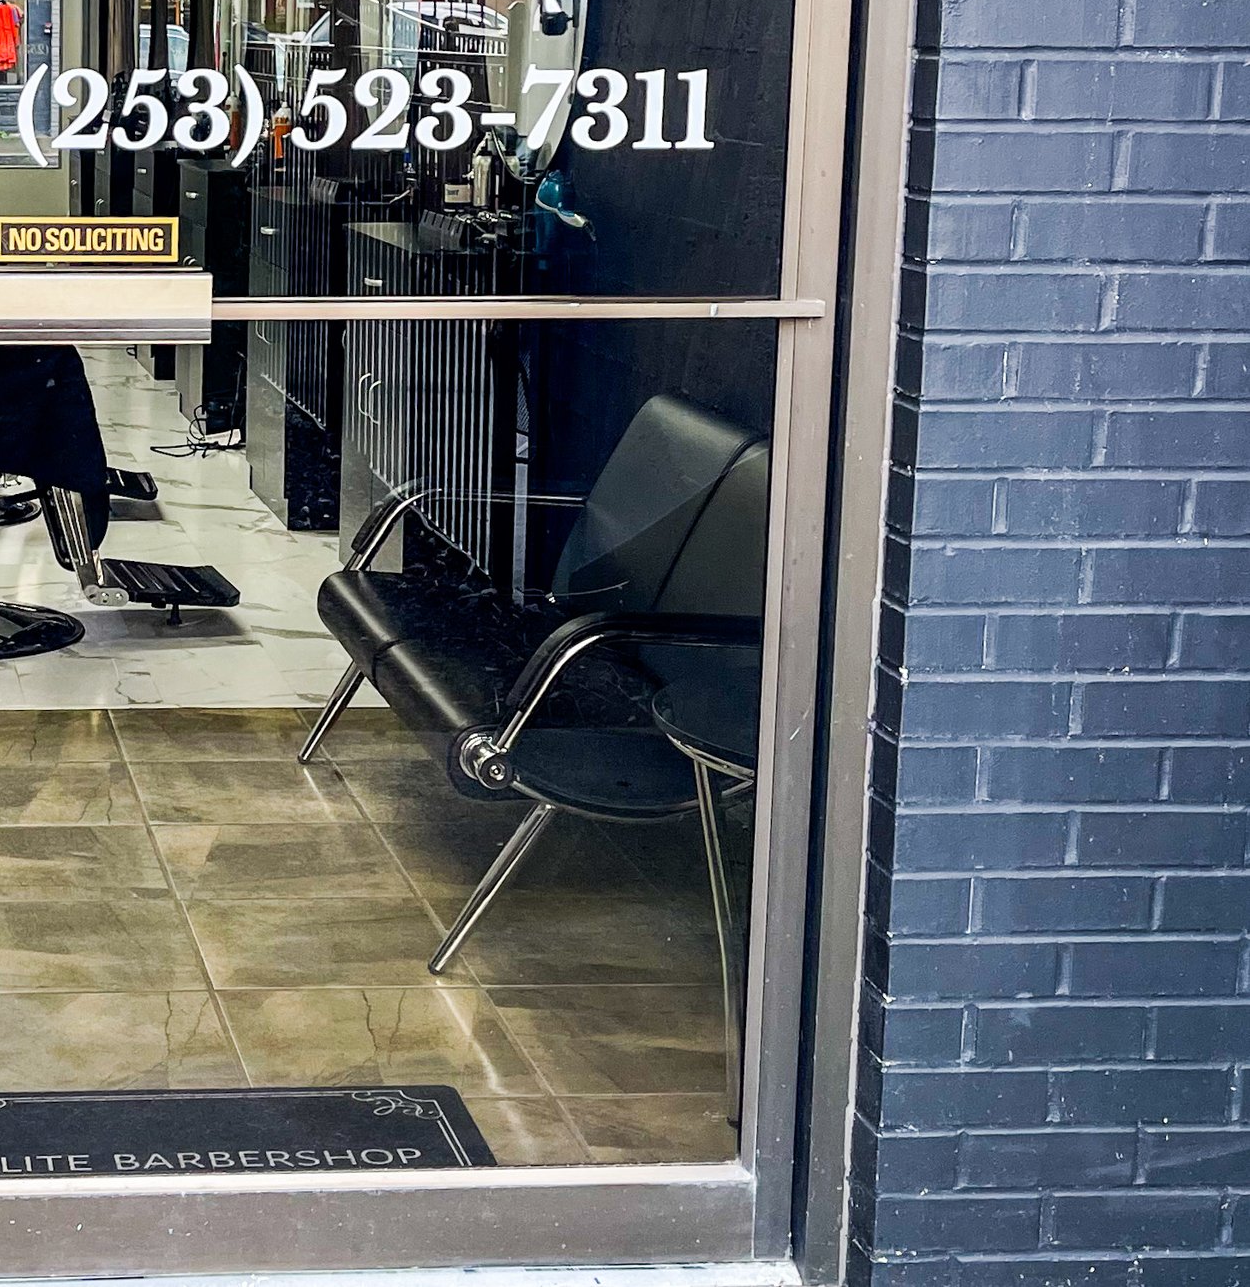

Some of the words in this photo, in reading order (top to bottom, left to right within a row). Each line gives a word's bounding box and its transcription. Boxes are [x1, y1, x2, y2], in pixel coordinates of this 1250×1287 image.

[17, 63, 262, 167] (253)
[291, 67, 715, 153] 523-7311
[9, 227, 42, 252] NO
[44, 227, 164, 252] SOLICITING
[114, 1147, 422, 1171] BARBERSHOP
